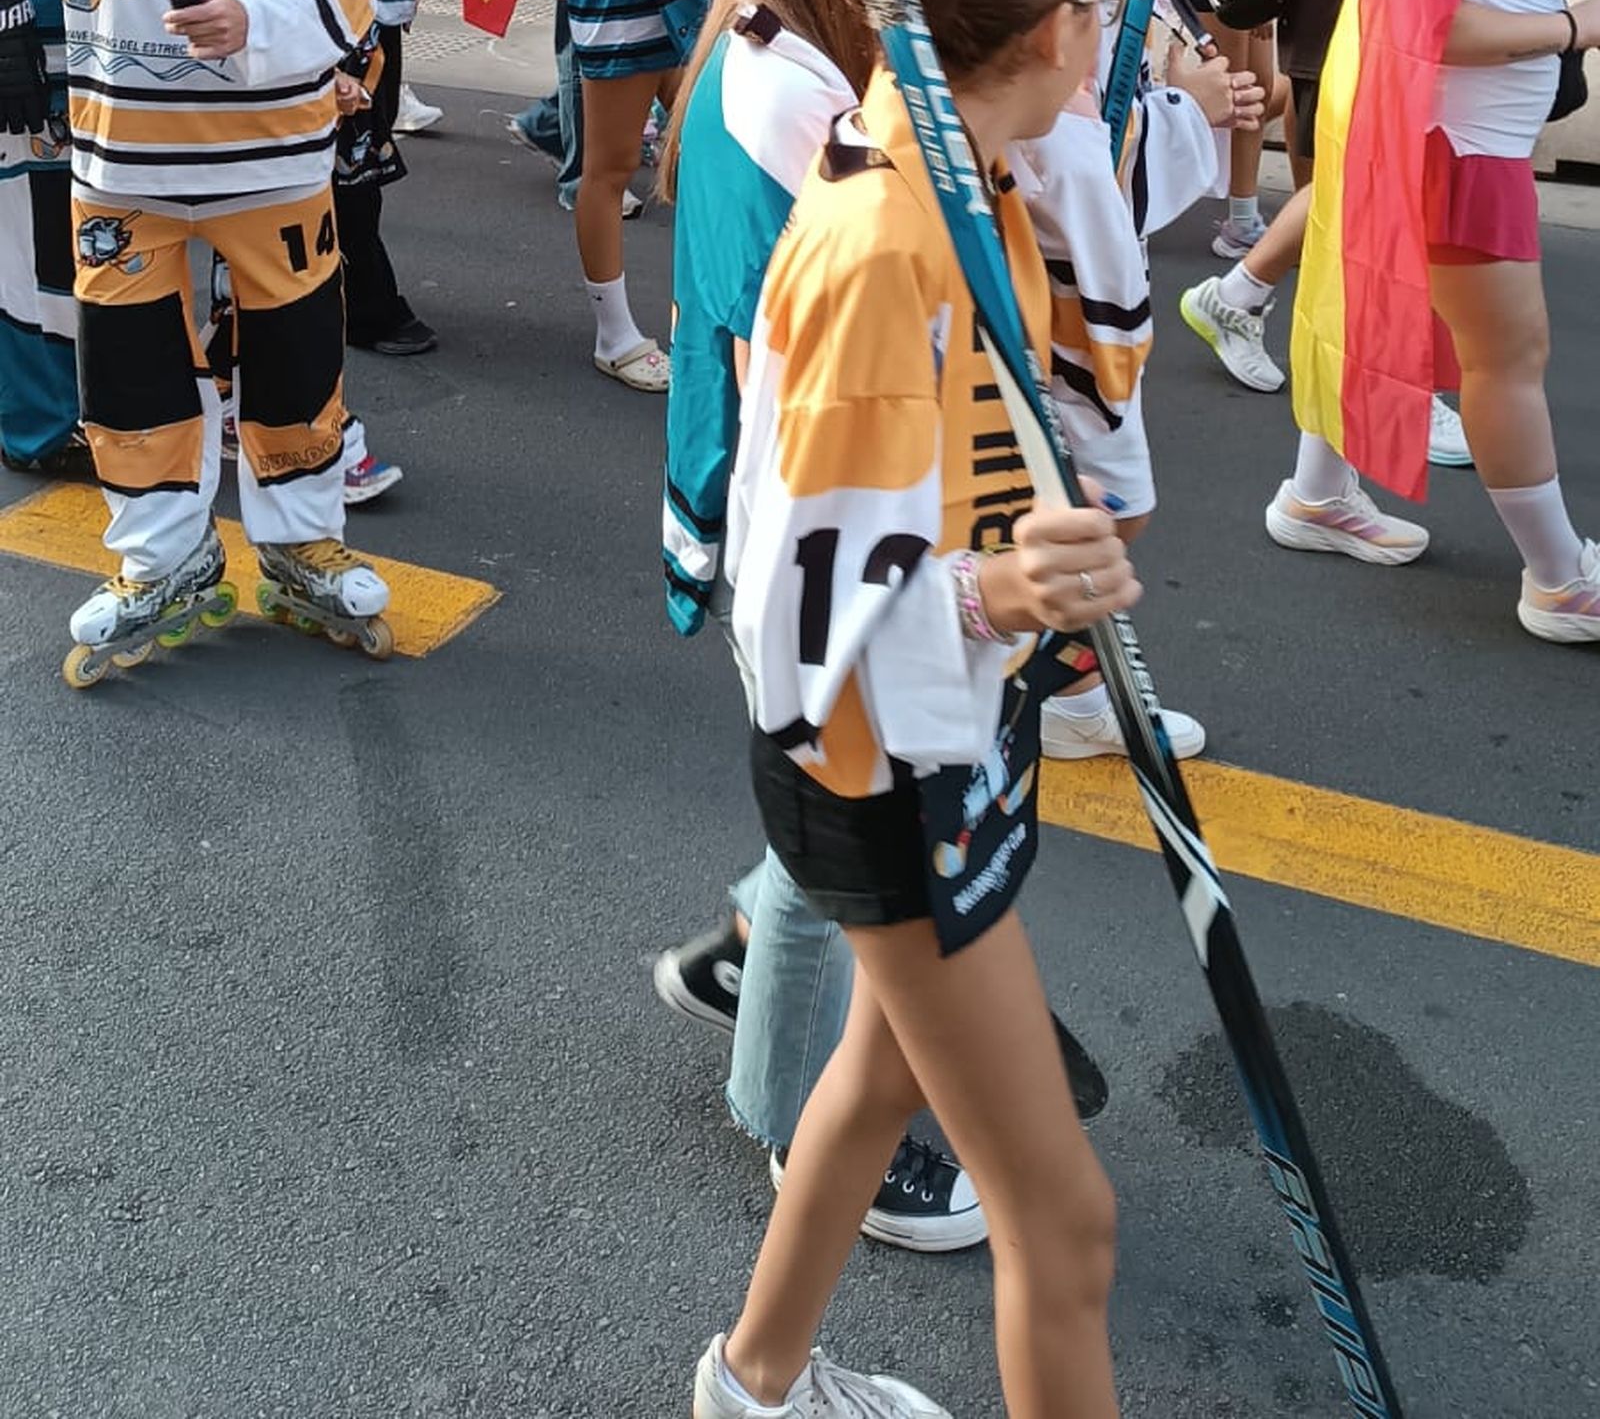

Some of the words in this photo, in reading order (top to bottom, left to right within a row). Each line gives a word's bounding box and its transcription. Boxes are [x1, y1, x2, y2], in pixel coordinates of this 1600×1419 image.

[120, 40, 138, 51] DEL
[143, 41, 189, 55] ESTREC
[903, 83, 957, 194] BAUER
[280, 209, 336, 273] 14
[1262, 1146, 1388, 1419] BAUE
